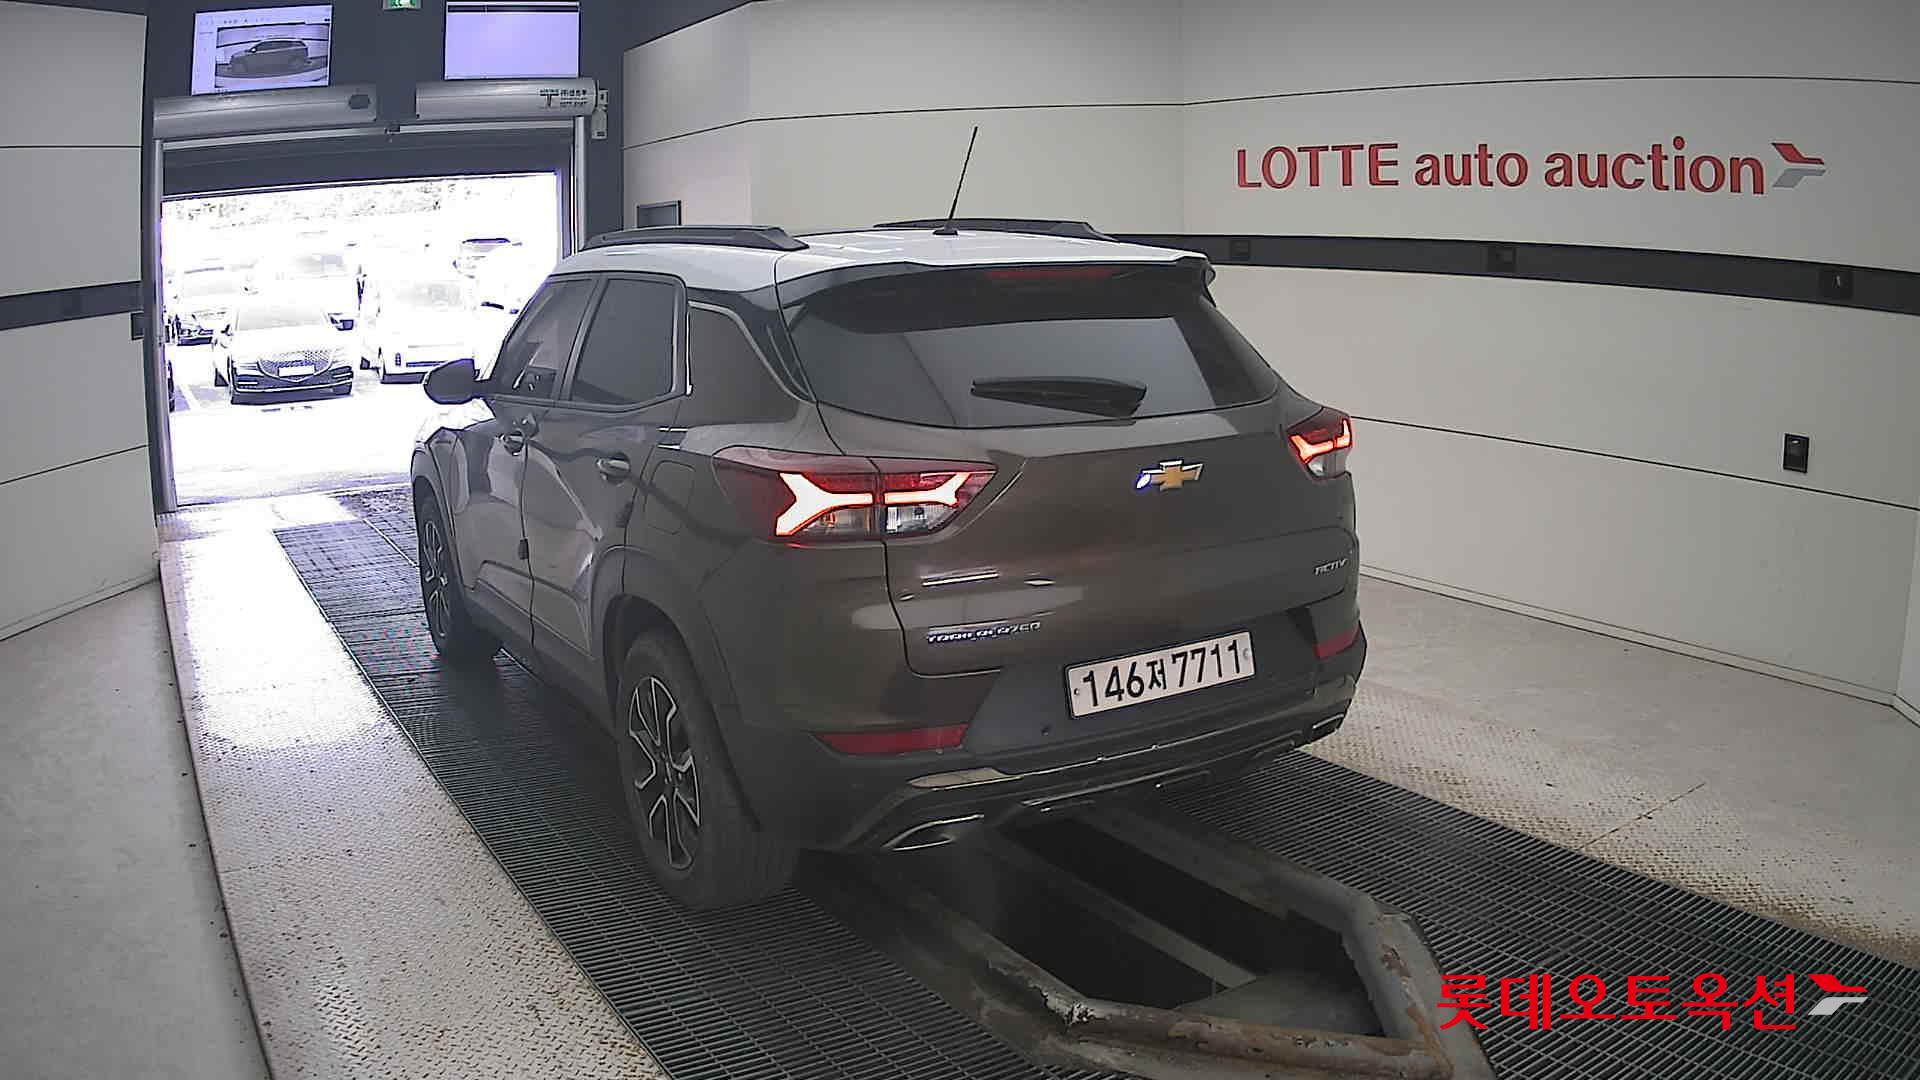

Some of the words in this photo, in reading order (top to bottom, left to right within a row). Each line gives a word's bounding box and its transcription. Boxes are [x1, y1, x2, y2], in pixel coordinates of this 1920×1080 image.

[1236, 142, 1400, 189] LOTTE
[1414, 143, 1529, 187] auto
[1544, 135, 1766, 195] auction
[1082, 638, 1242, 707] 146저7711
